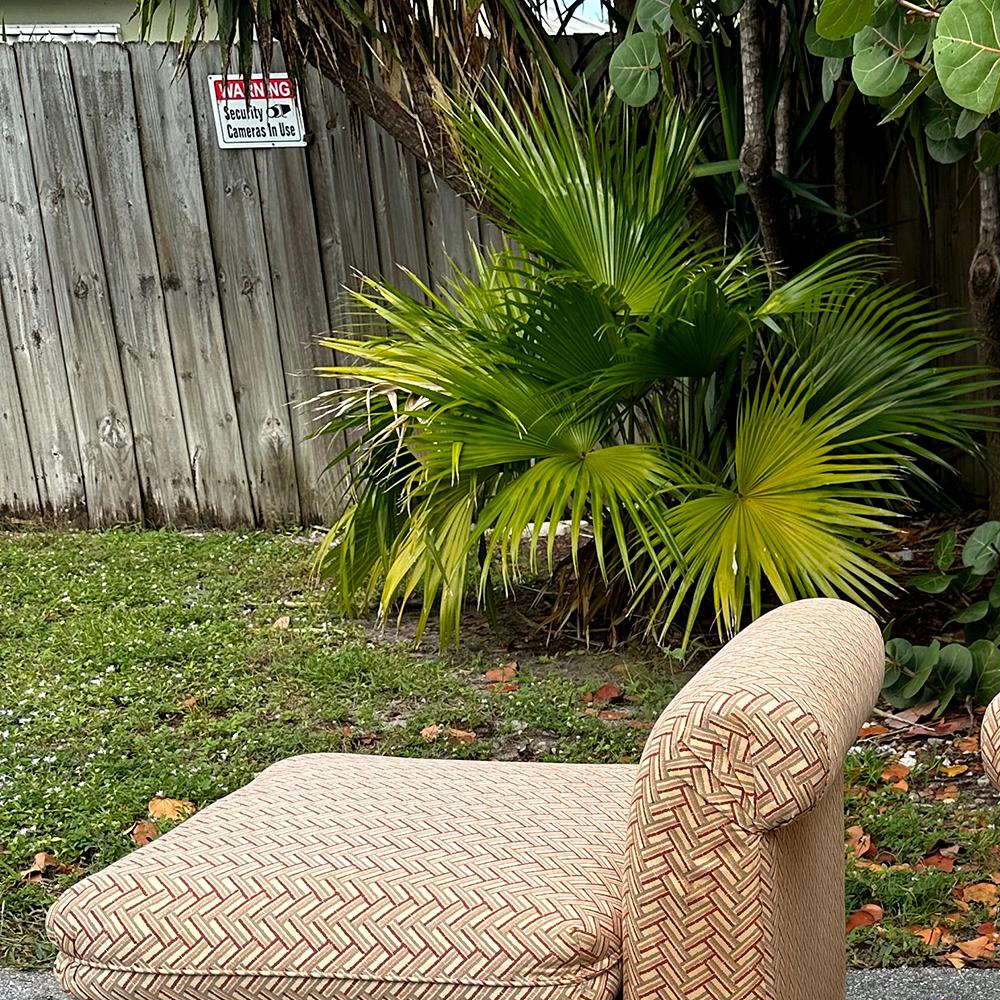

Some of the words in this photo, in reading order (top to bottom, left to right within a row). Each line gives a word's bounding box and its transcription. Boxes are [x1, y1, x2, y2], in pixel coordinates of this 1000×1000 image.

[218, 81, 290, 98] WANNG
[223, 105, 263, 122] Security
[226, 124, 267, 139] Cameras
[268, 122, 278, 137] In
[279, 122, 296, 137] Use
